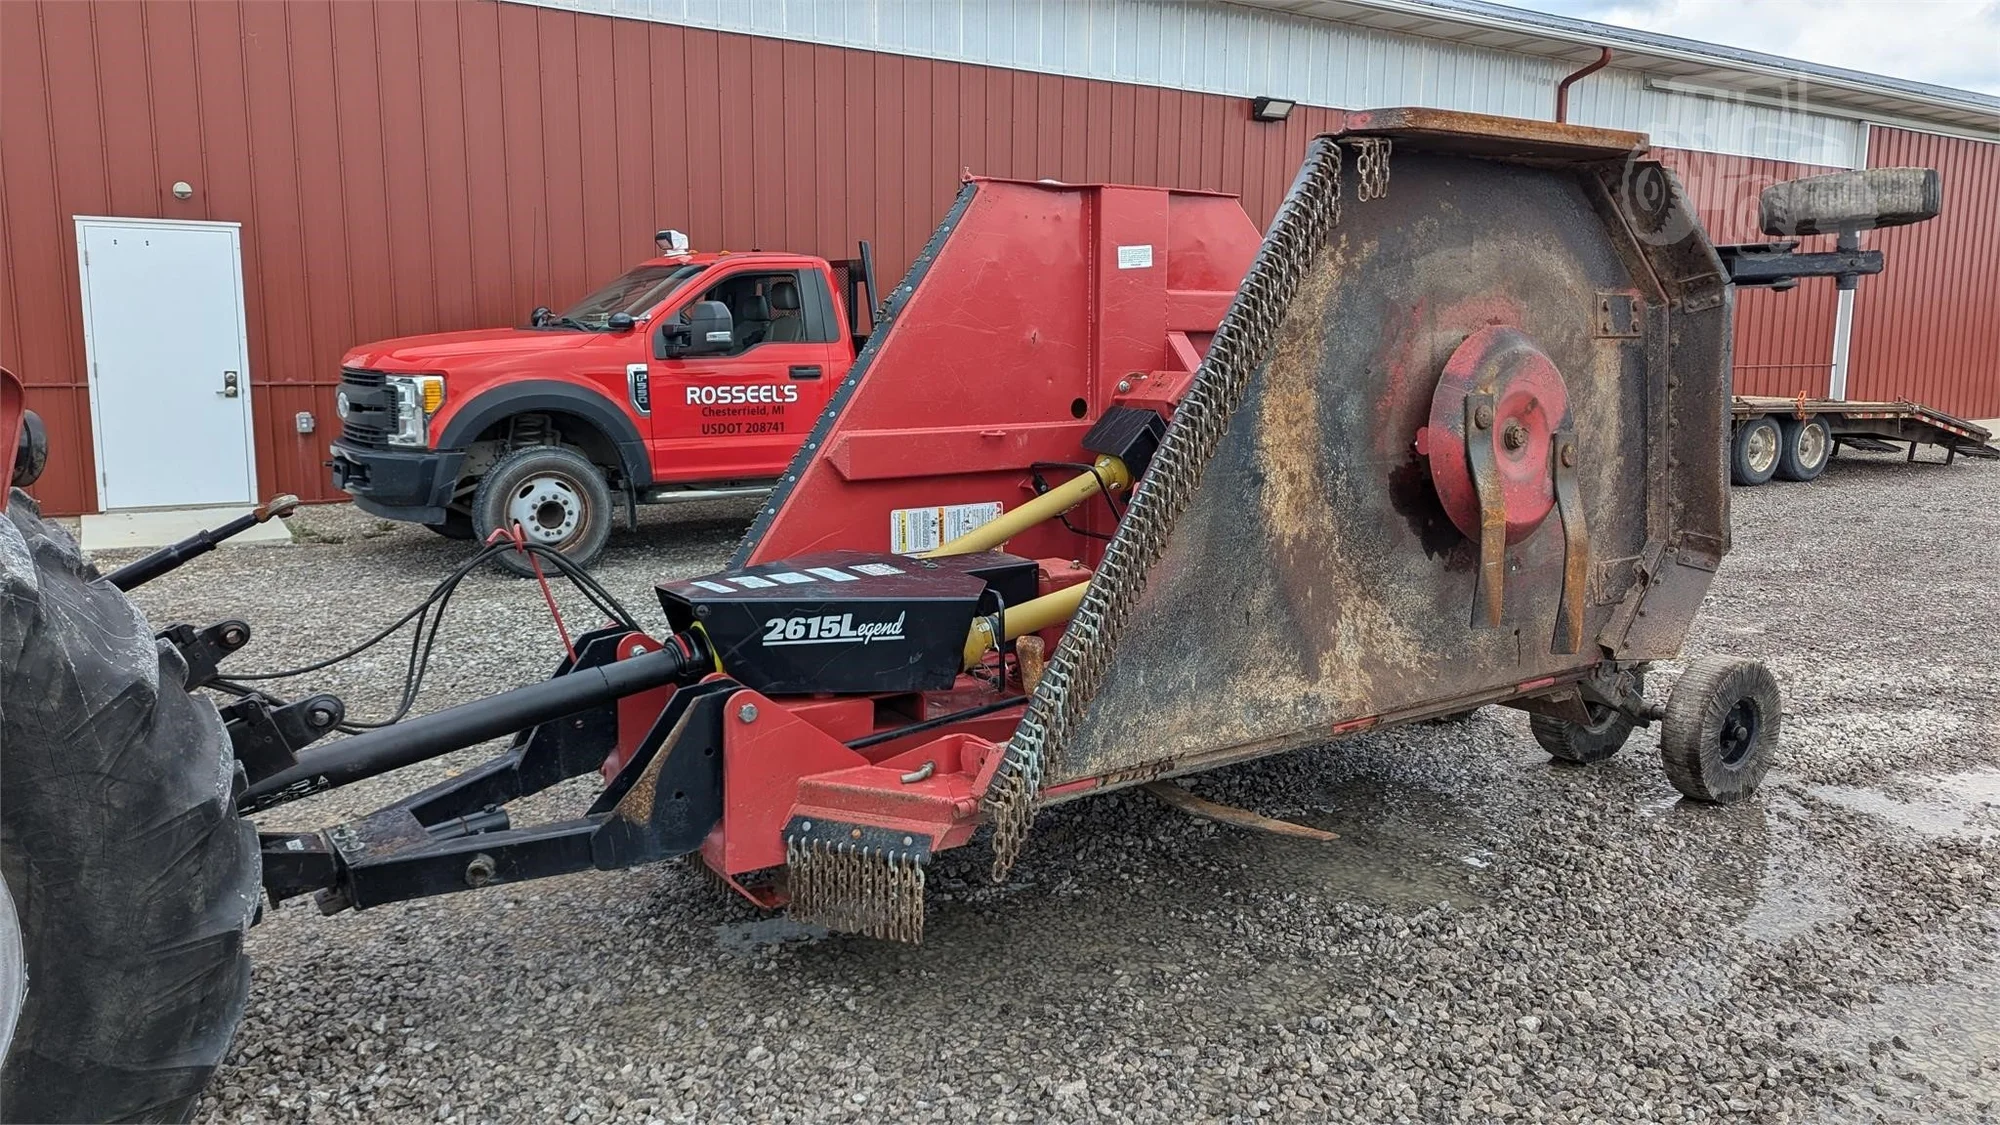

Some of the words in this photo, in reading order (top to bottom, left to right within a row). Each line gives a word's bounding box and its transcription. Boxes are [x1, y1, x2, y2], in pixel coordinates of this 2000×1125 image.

[686, 385, 798, 405] ROSSEEL'S
[701, 405, 770, 417] Chesterfield,
[772, 405, 785, 415] MI
[701, 423, 743, 435] USDOT
[745, 422, 785, 434] 208741
